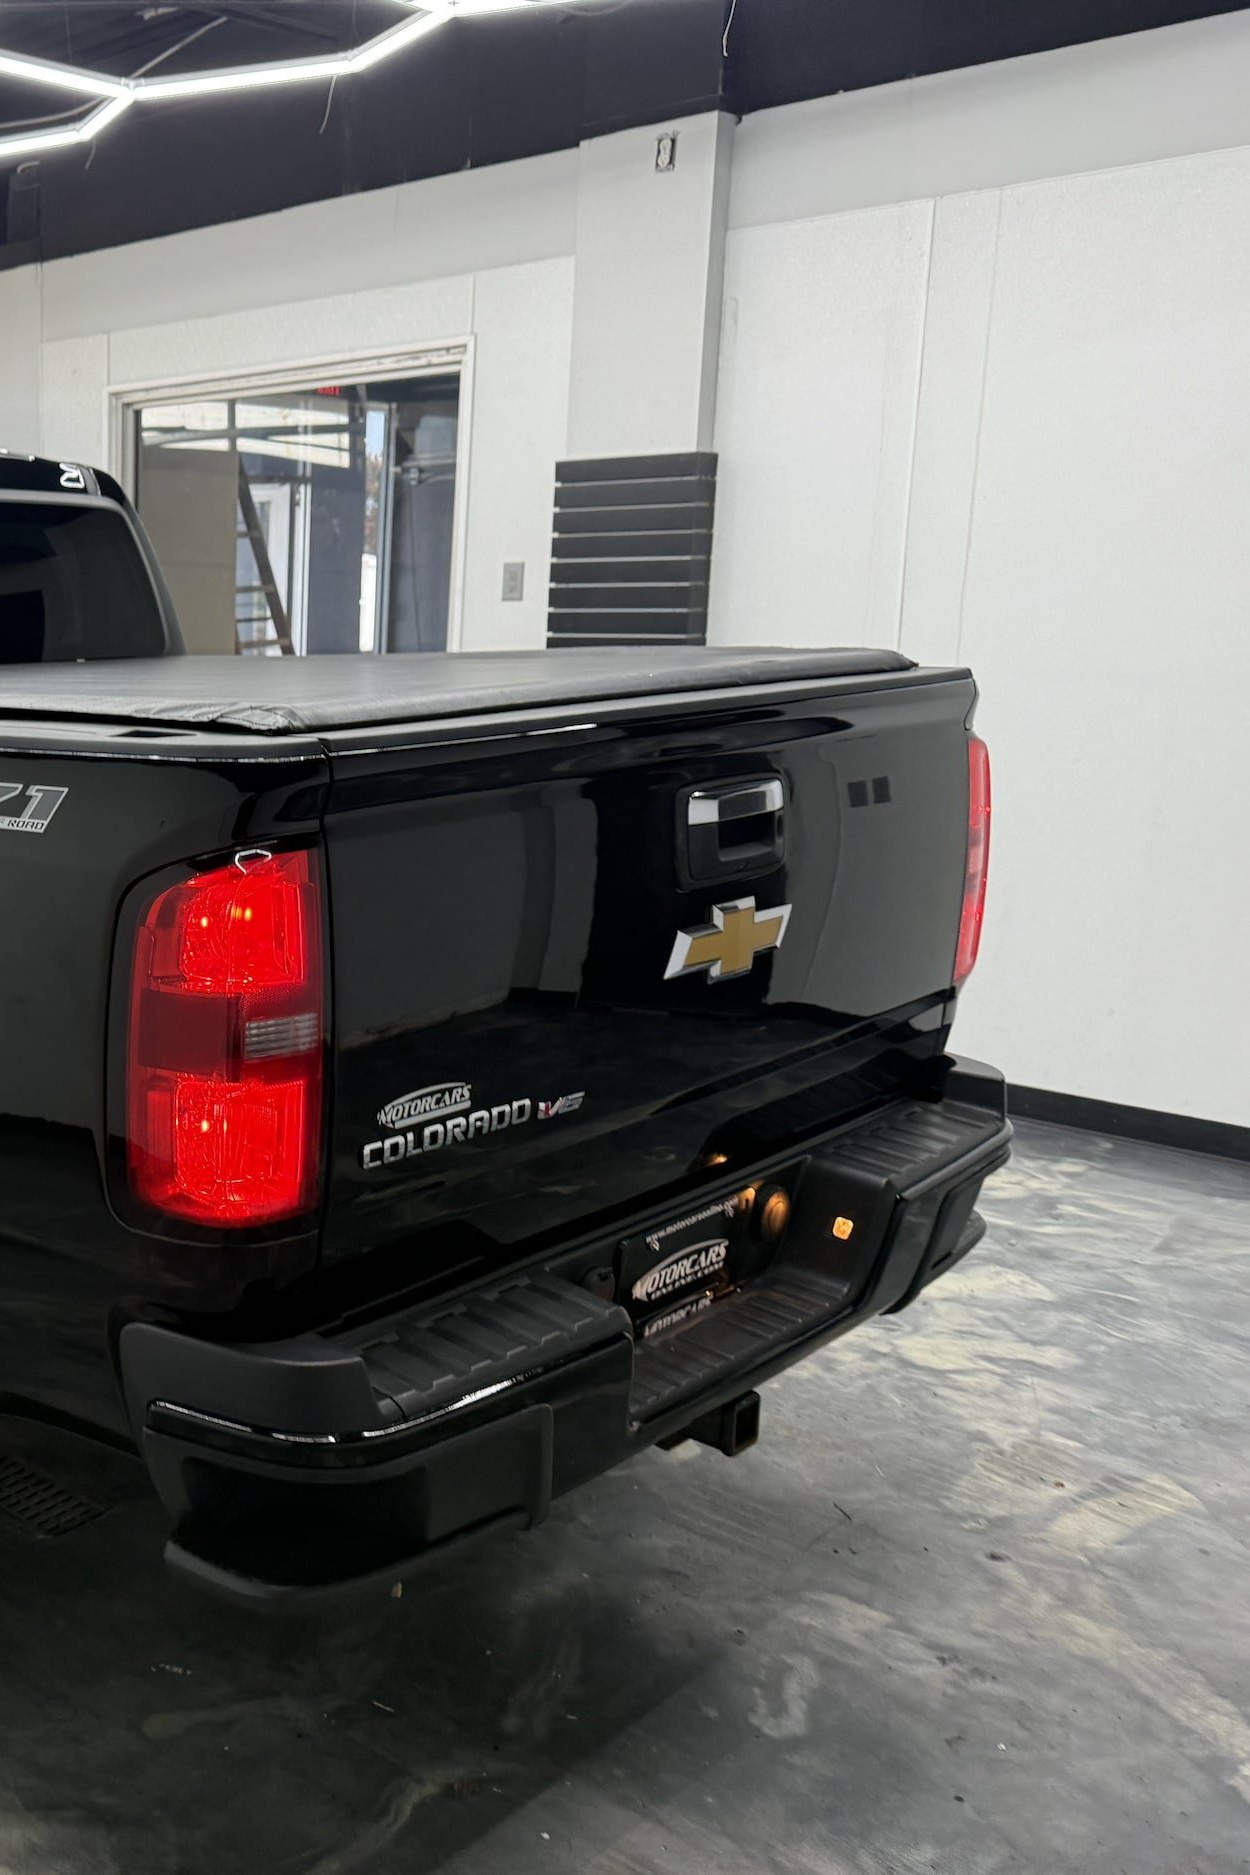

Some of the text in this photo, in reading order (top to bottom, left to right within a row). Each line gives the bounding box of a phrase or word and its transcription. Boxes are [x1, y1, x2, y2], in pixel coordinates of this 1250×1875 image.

[7, 819, 45, 830] ROAD
[362, 1091, 586, 1170] COLORADO V6
[377, 1083, 472, 1127] MOTORCARS
[632, 1243, 728, 1301] MOTORCARS
